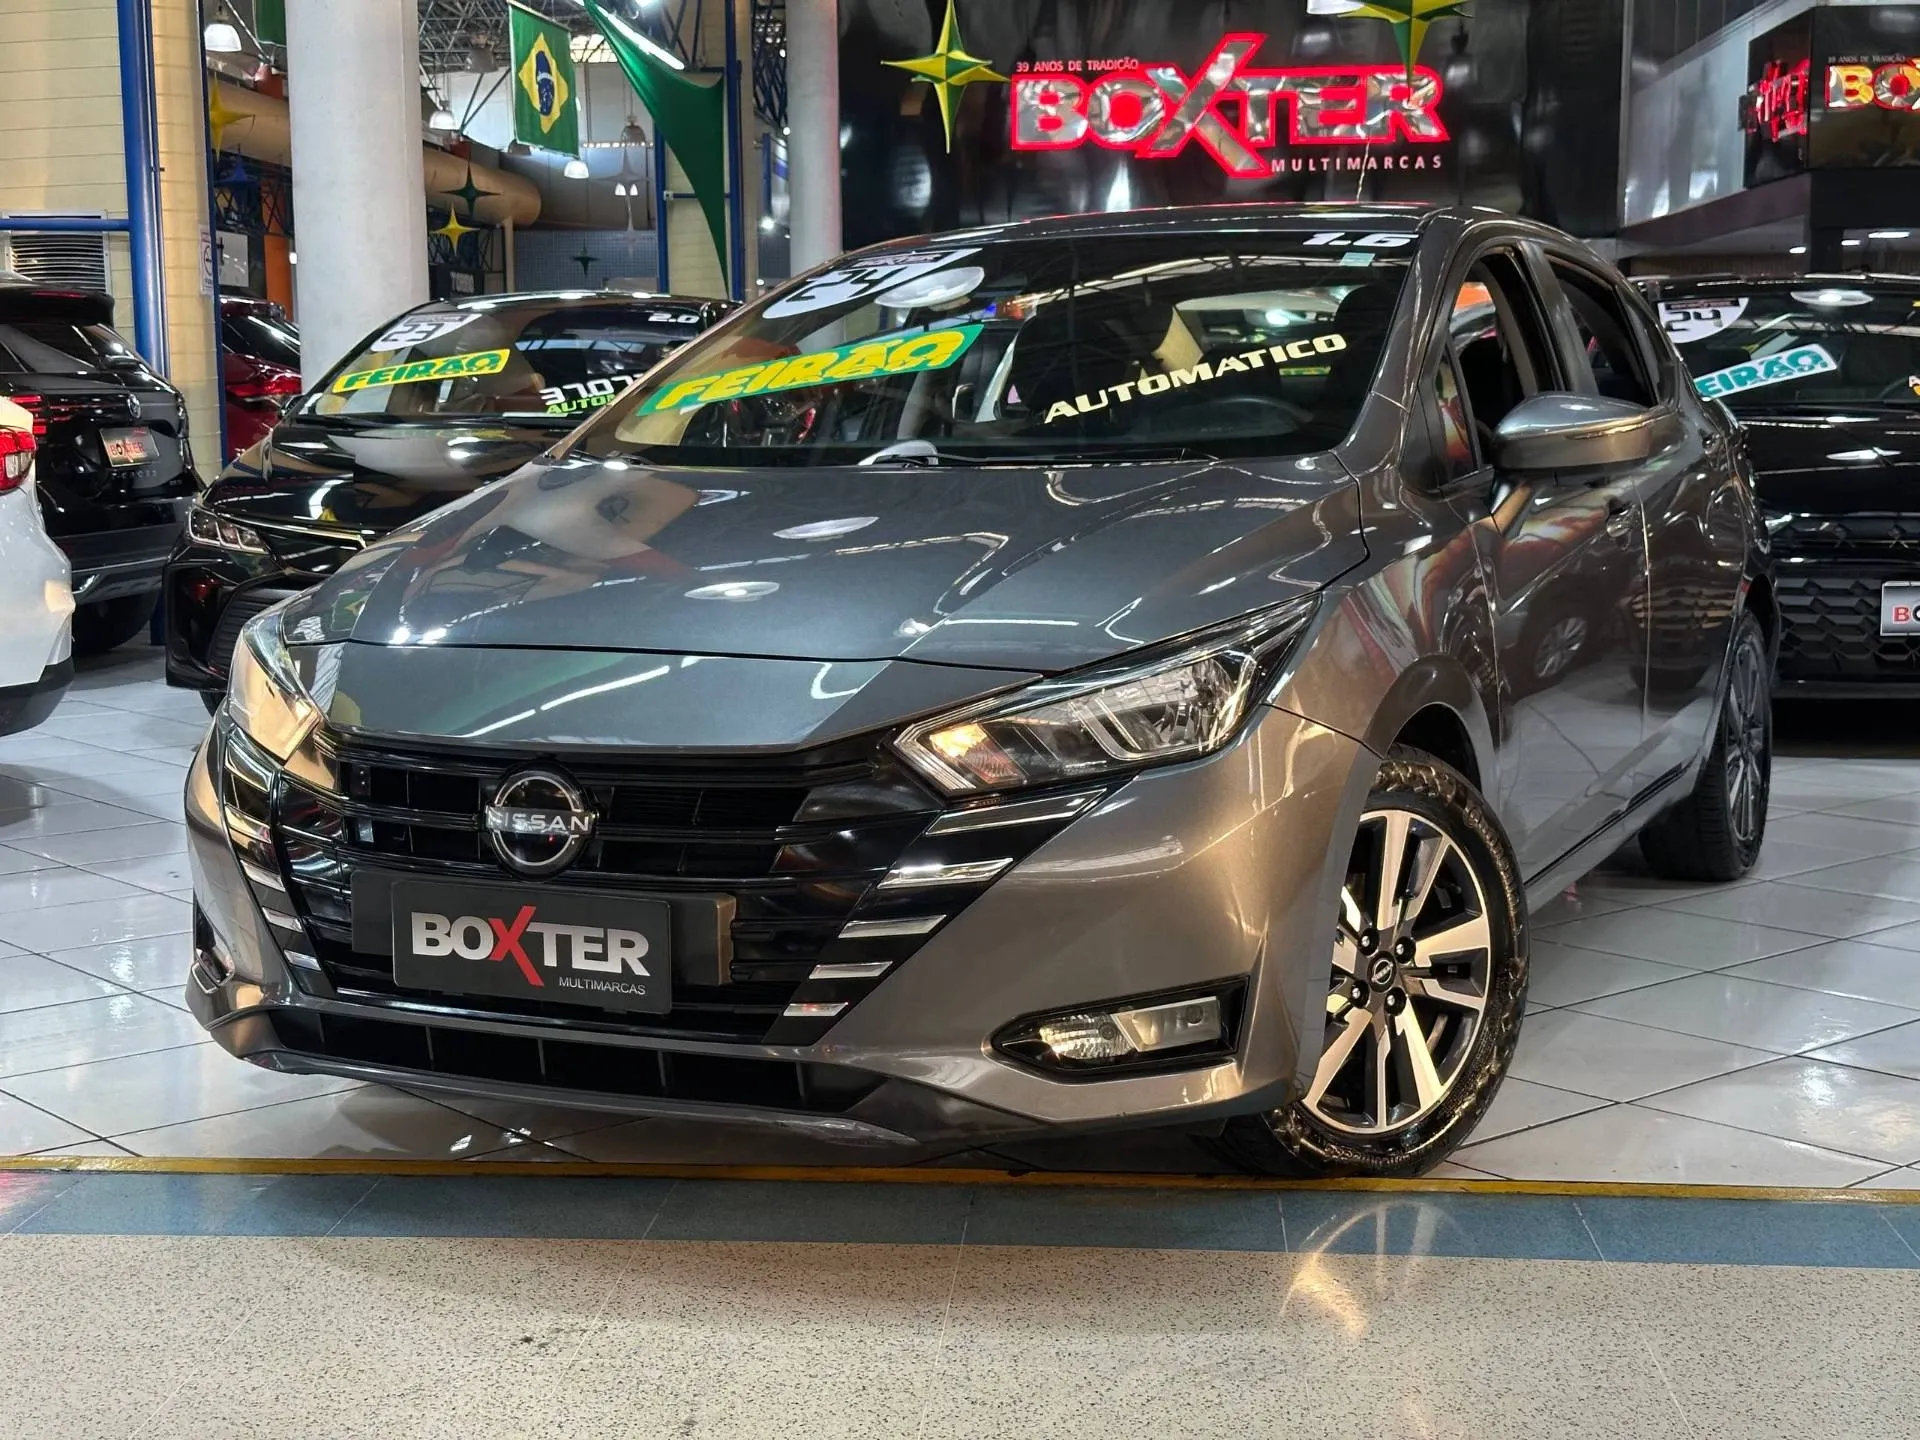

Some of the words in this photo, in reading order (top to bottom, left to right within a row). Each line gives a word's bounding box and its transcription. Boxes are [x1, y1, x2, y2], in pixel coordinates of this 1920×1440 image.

[1016, 61, 1029, 72] 39
[1033, 61, 1063, 72] ANOS
[1068, 60, 1082, 71] DE
[1086, 56, 1139, 70] TRADIÇÃO
[1825, 57, 1920, 112] BO
[1011, 32, 1450, 179] BOXTER
[1271, 155, 1442, 174] MULTIMARCAS
[1302, 232, 1419, 248] 1.6
[786, 266, 908, 302] 24
[647, 312, 700, 324] 2.0
[1665, 308, 1722, 332] 24
[381, 322, 445, 342] 23
[1695, 350, 1829, 397] EIRÃO
[411, 905, 651, 987] BOXTER
[558, 976, 646, 995] MULTIMARCAS
